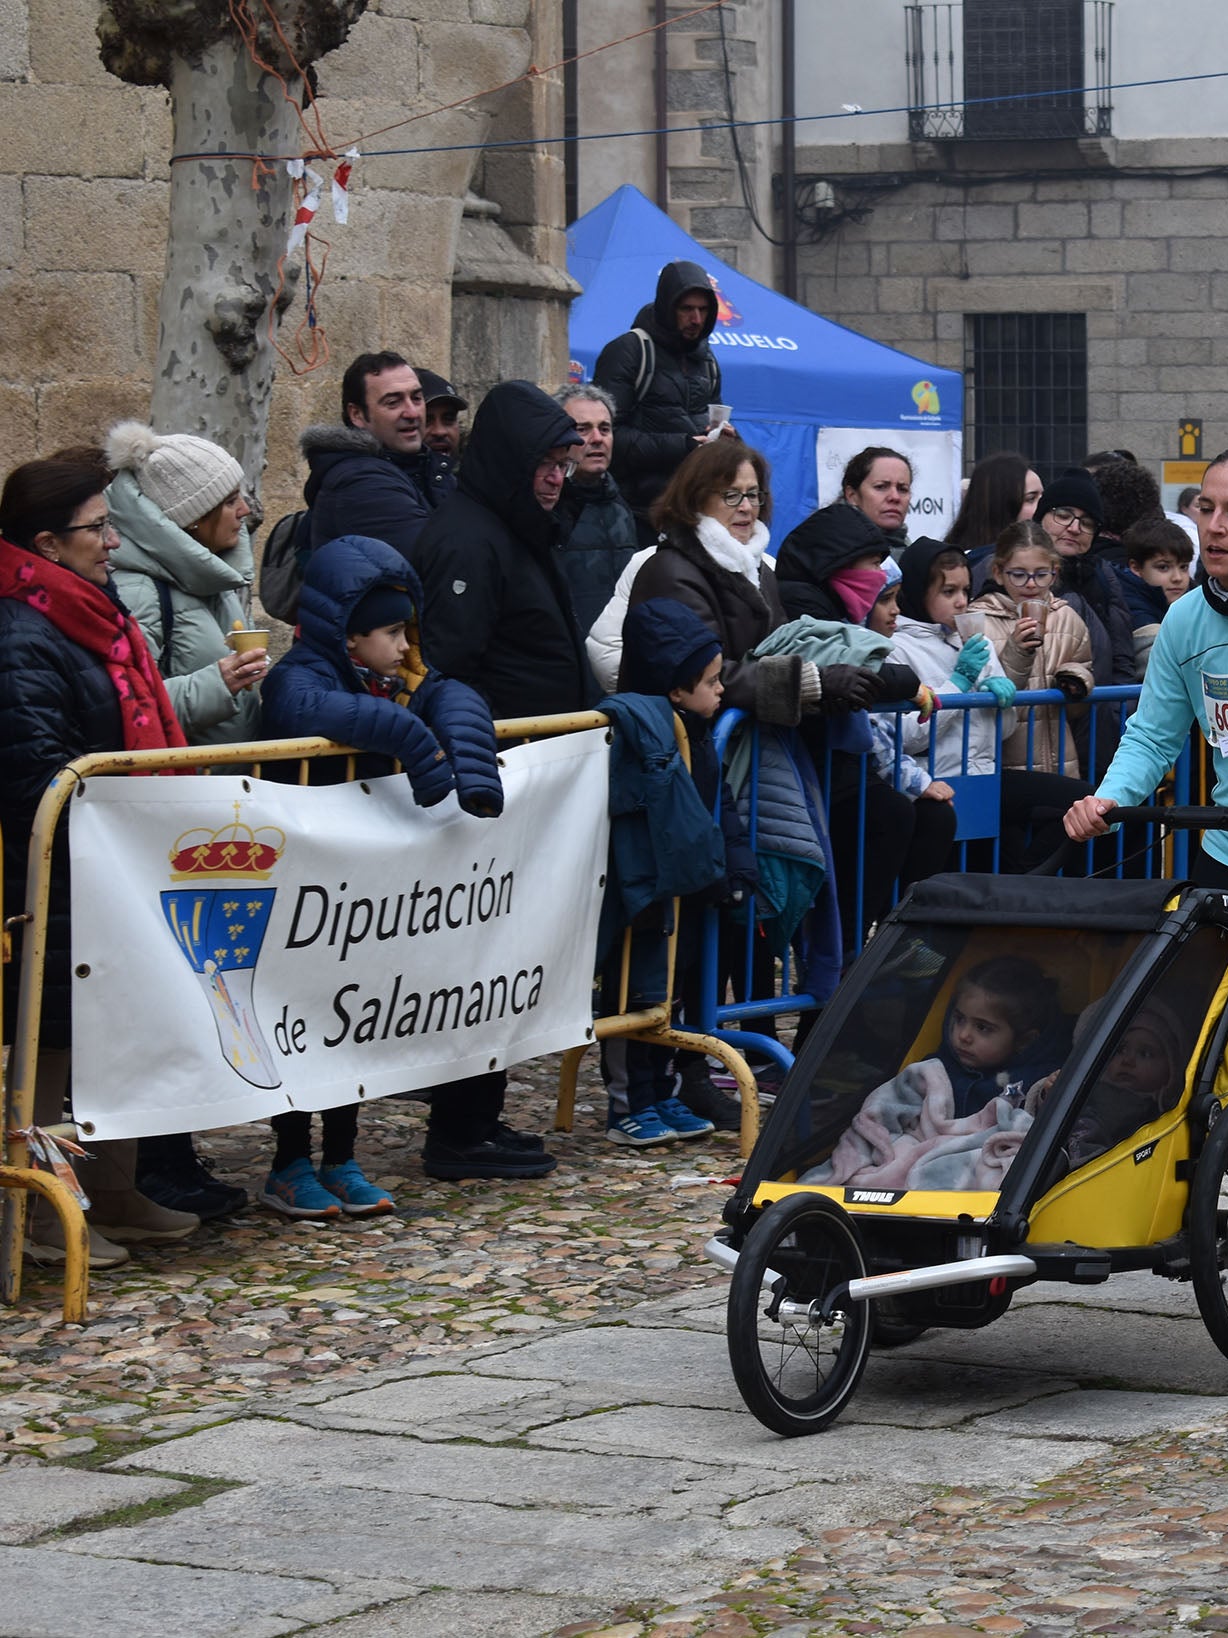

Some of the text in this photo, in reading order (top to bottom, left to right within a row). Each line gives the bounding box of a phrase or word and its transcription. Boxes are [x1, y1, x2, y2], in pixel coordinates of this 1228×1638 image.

[284, 857, 515, 962] Diputación
[273, 964, 544, 1057] de Salamanca
[852, 1190, 895, 1203] THULE
